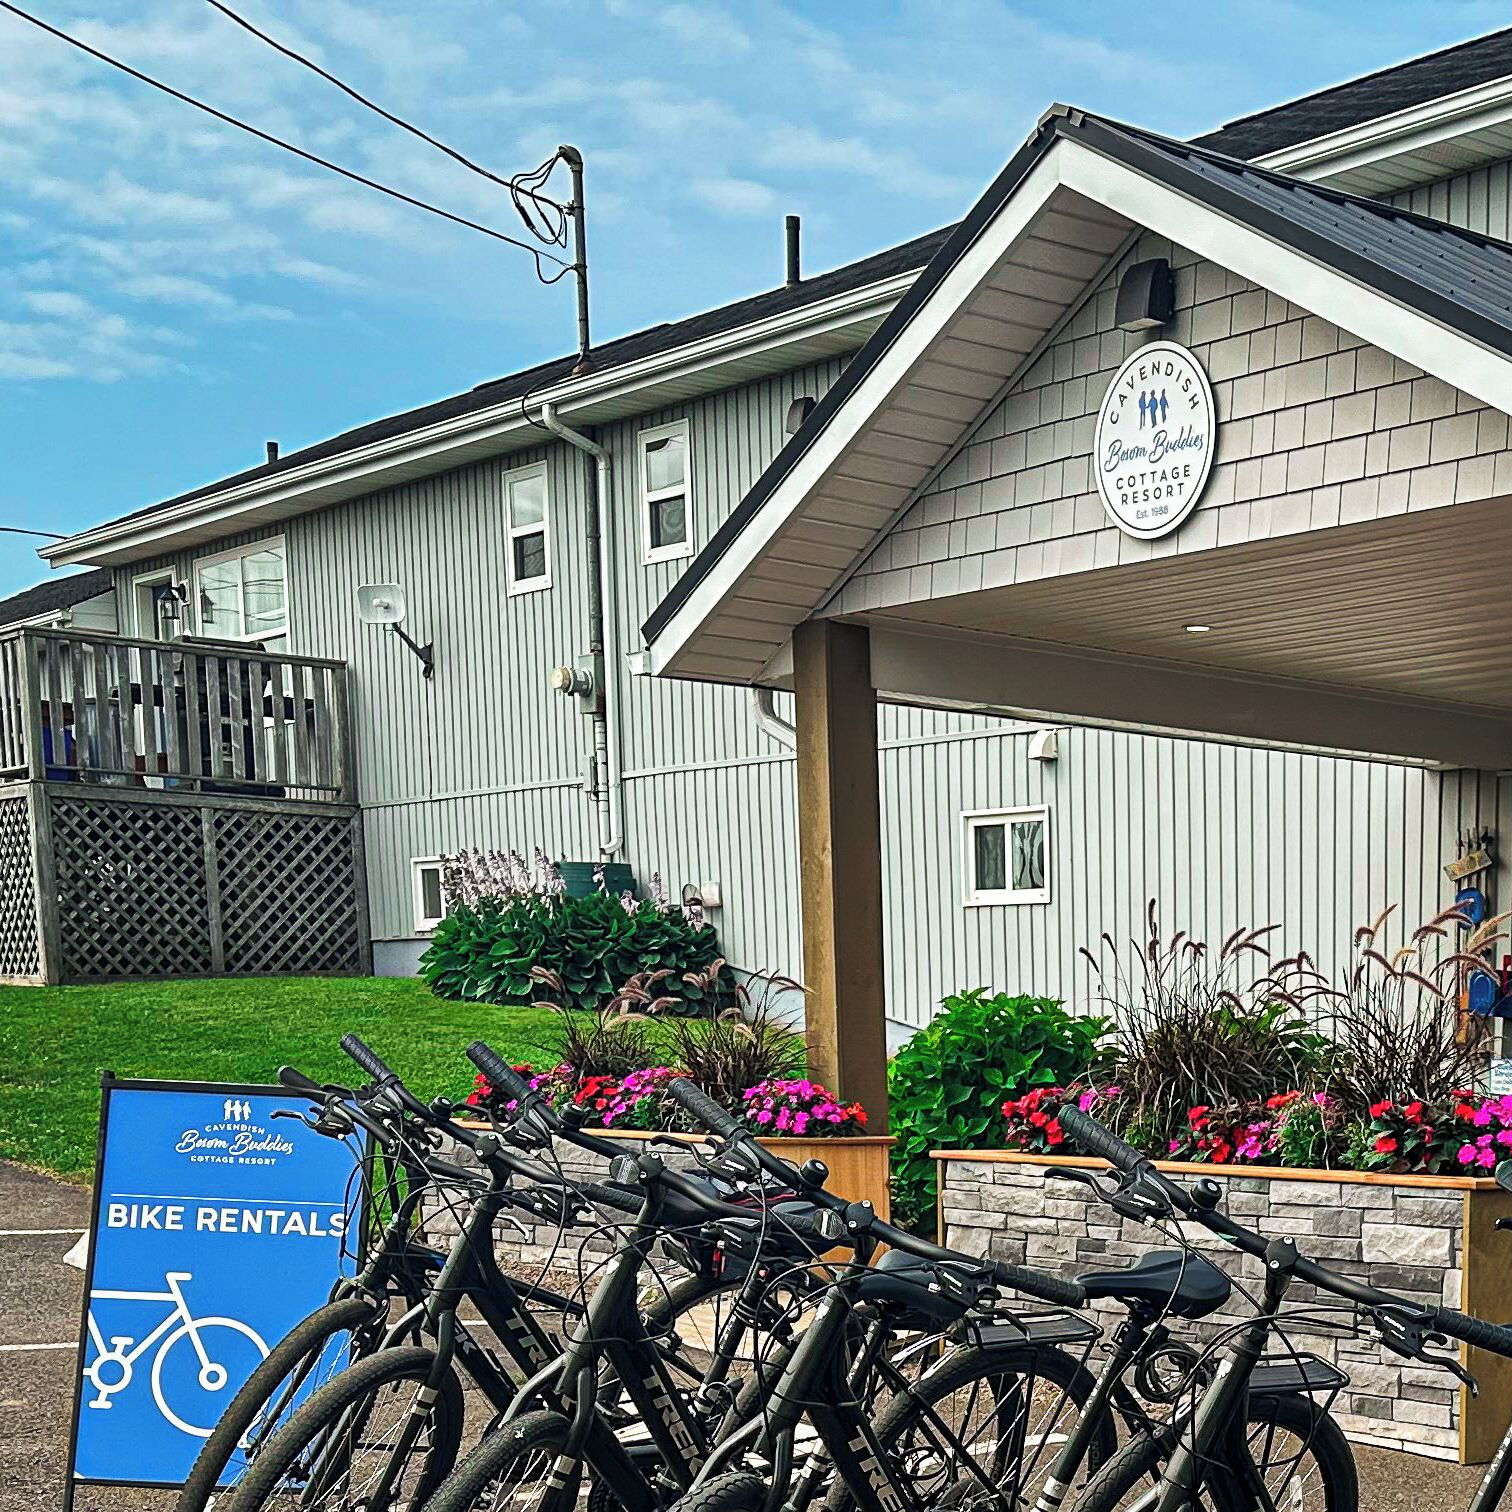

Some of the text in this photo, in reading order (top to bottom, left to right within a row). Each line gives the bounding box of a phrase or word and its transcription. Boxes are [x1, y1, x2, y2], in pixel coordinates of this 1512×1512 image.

[1110, 361, 1200, 425] CAVENDISH
[1104, 424, 1204, 472] Bosom Buddies
[1116, 464, 1191, 490] COTTAGE
[1121, 483, 1185, 506] RESORT
[175, 1129, 294, 1156] Bosom Buddies
[204, 1123, 266, 1136] CAVENDISH
[190, 1155, 276, 1166] COTTAGE RESORT
[107, 1203, 351, 1238] BIKE RENTALS
[642, 1364, 704, 1478] TREK
